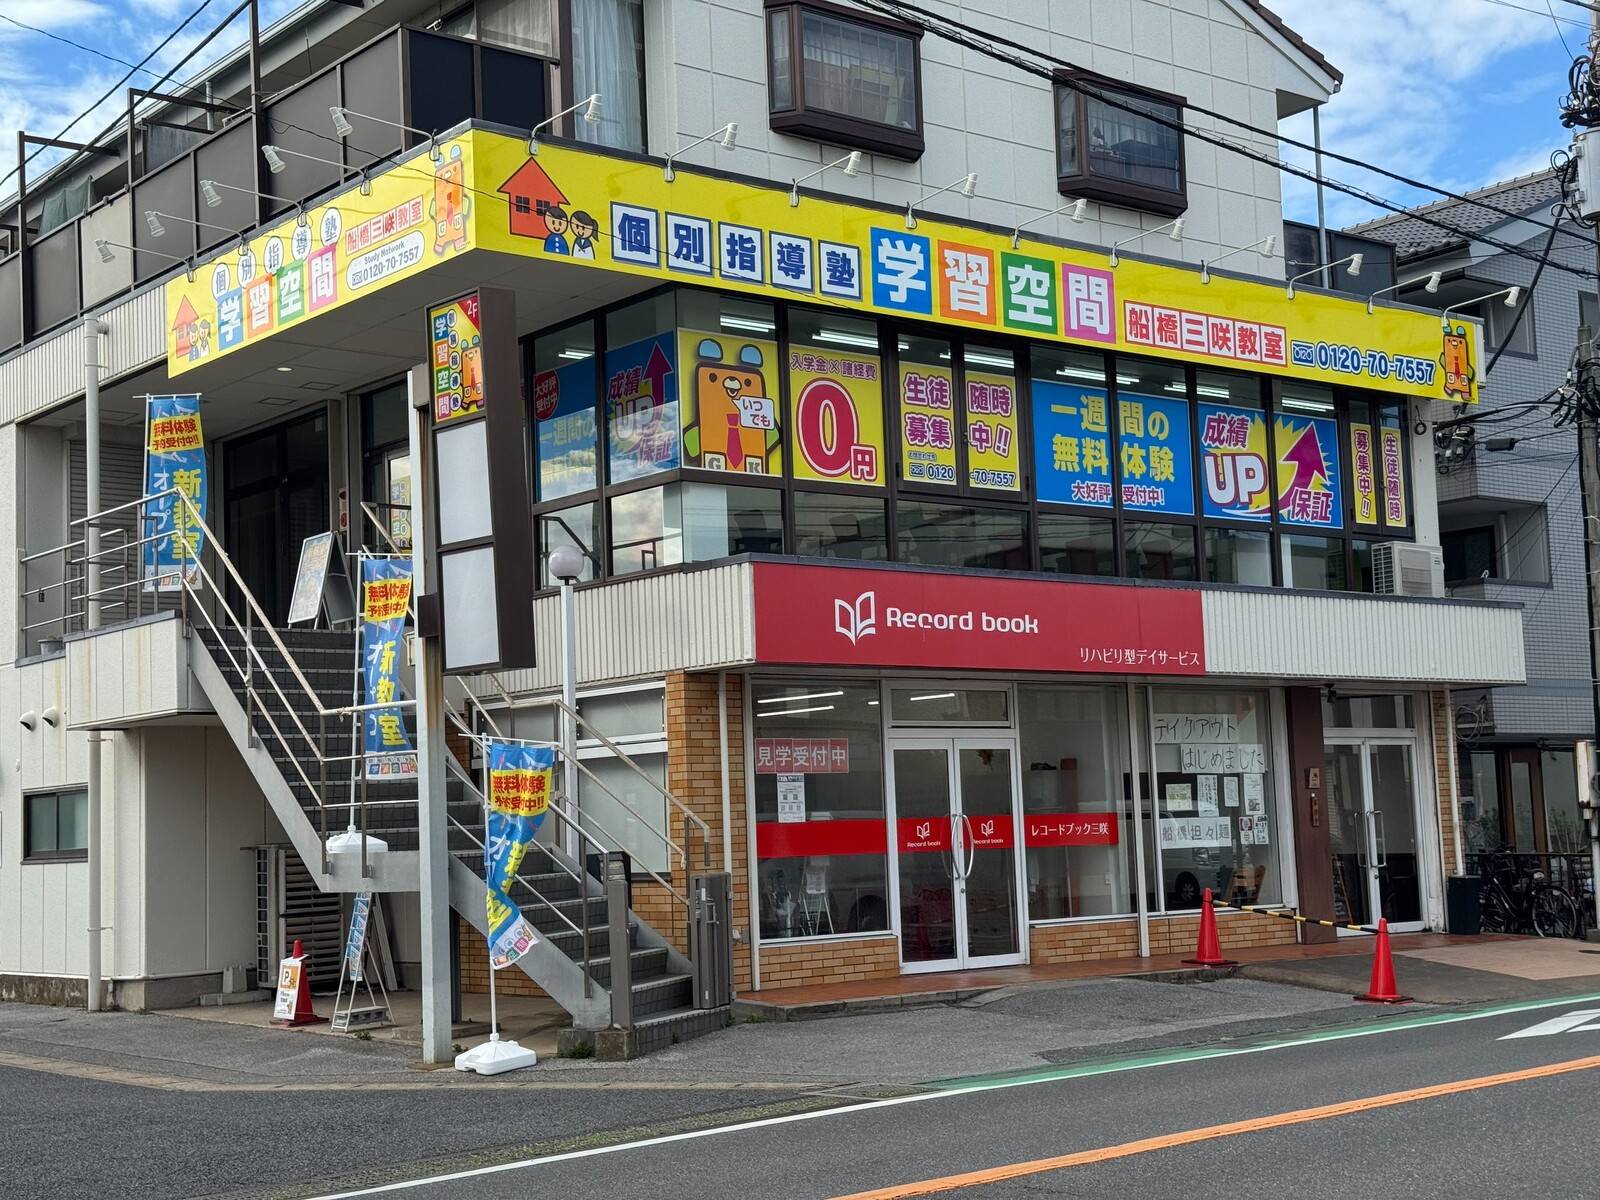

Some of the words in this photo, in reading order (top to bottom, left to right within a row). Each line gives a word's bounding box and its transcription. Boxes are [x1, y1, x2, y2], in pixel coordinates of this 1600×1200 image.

[347, 200, 422, 252] 船橋三咲教室
[214, 213, 339, 293] 個別指導塾
[363, 245, 420, 281] 0120-70-7557
[617, 212, 855, 288] 個別指導塾
[220, 252, 334, 342] 学習空間
[877, 237, 1110, 335] 学習空間
[467, 300, 478, 318] 2F
[1128, 303, 1285, 361] 船橋三咲教室
[1317, 341, 1435, 385] 0120-70-7557
[607, 365, 643, 401] 成績
[904, 373, 951, 409] 生徒
[967, 382, 1012, 416] 随時
[614, 394, 656, 441] UP
[742, 399, 764, 411] いつ
[750, 413, 771, 428] でも
[638, 430, 675, 468] 保証
[905, 412, 953, 449] 募集
[1202, 412, 1251, 449] 成績
[927, 463, 955, 481] 0120
[1204, 453, 1269, 505] UP
[1383, 432, 1402, 521] 生徒随時
[1289, 487, 1334, 523] 保証
[886, 607, 973, 630] Record
[981, 612, 1039, 634] book
[1080, 647, 1200, 666] リハビリ型デイサービス
[1155, 717, 1236, 741] テイクアウト
[757, 746, 846, 766] 見学受付中
[1182, 747, 1264, 770] はじめました
[1031, 822, 1109, 837] レコードブック三咲
